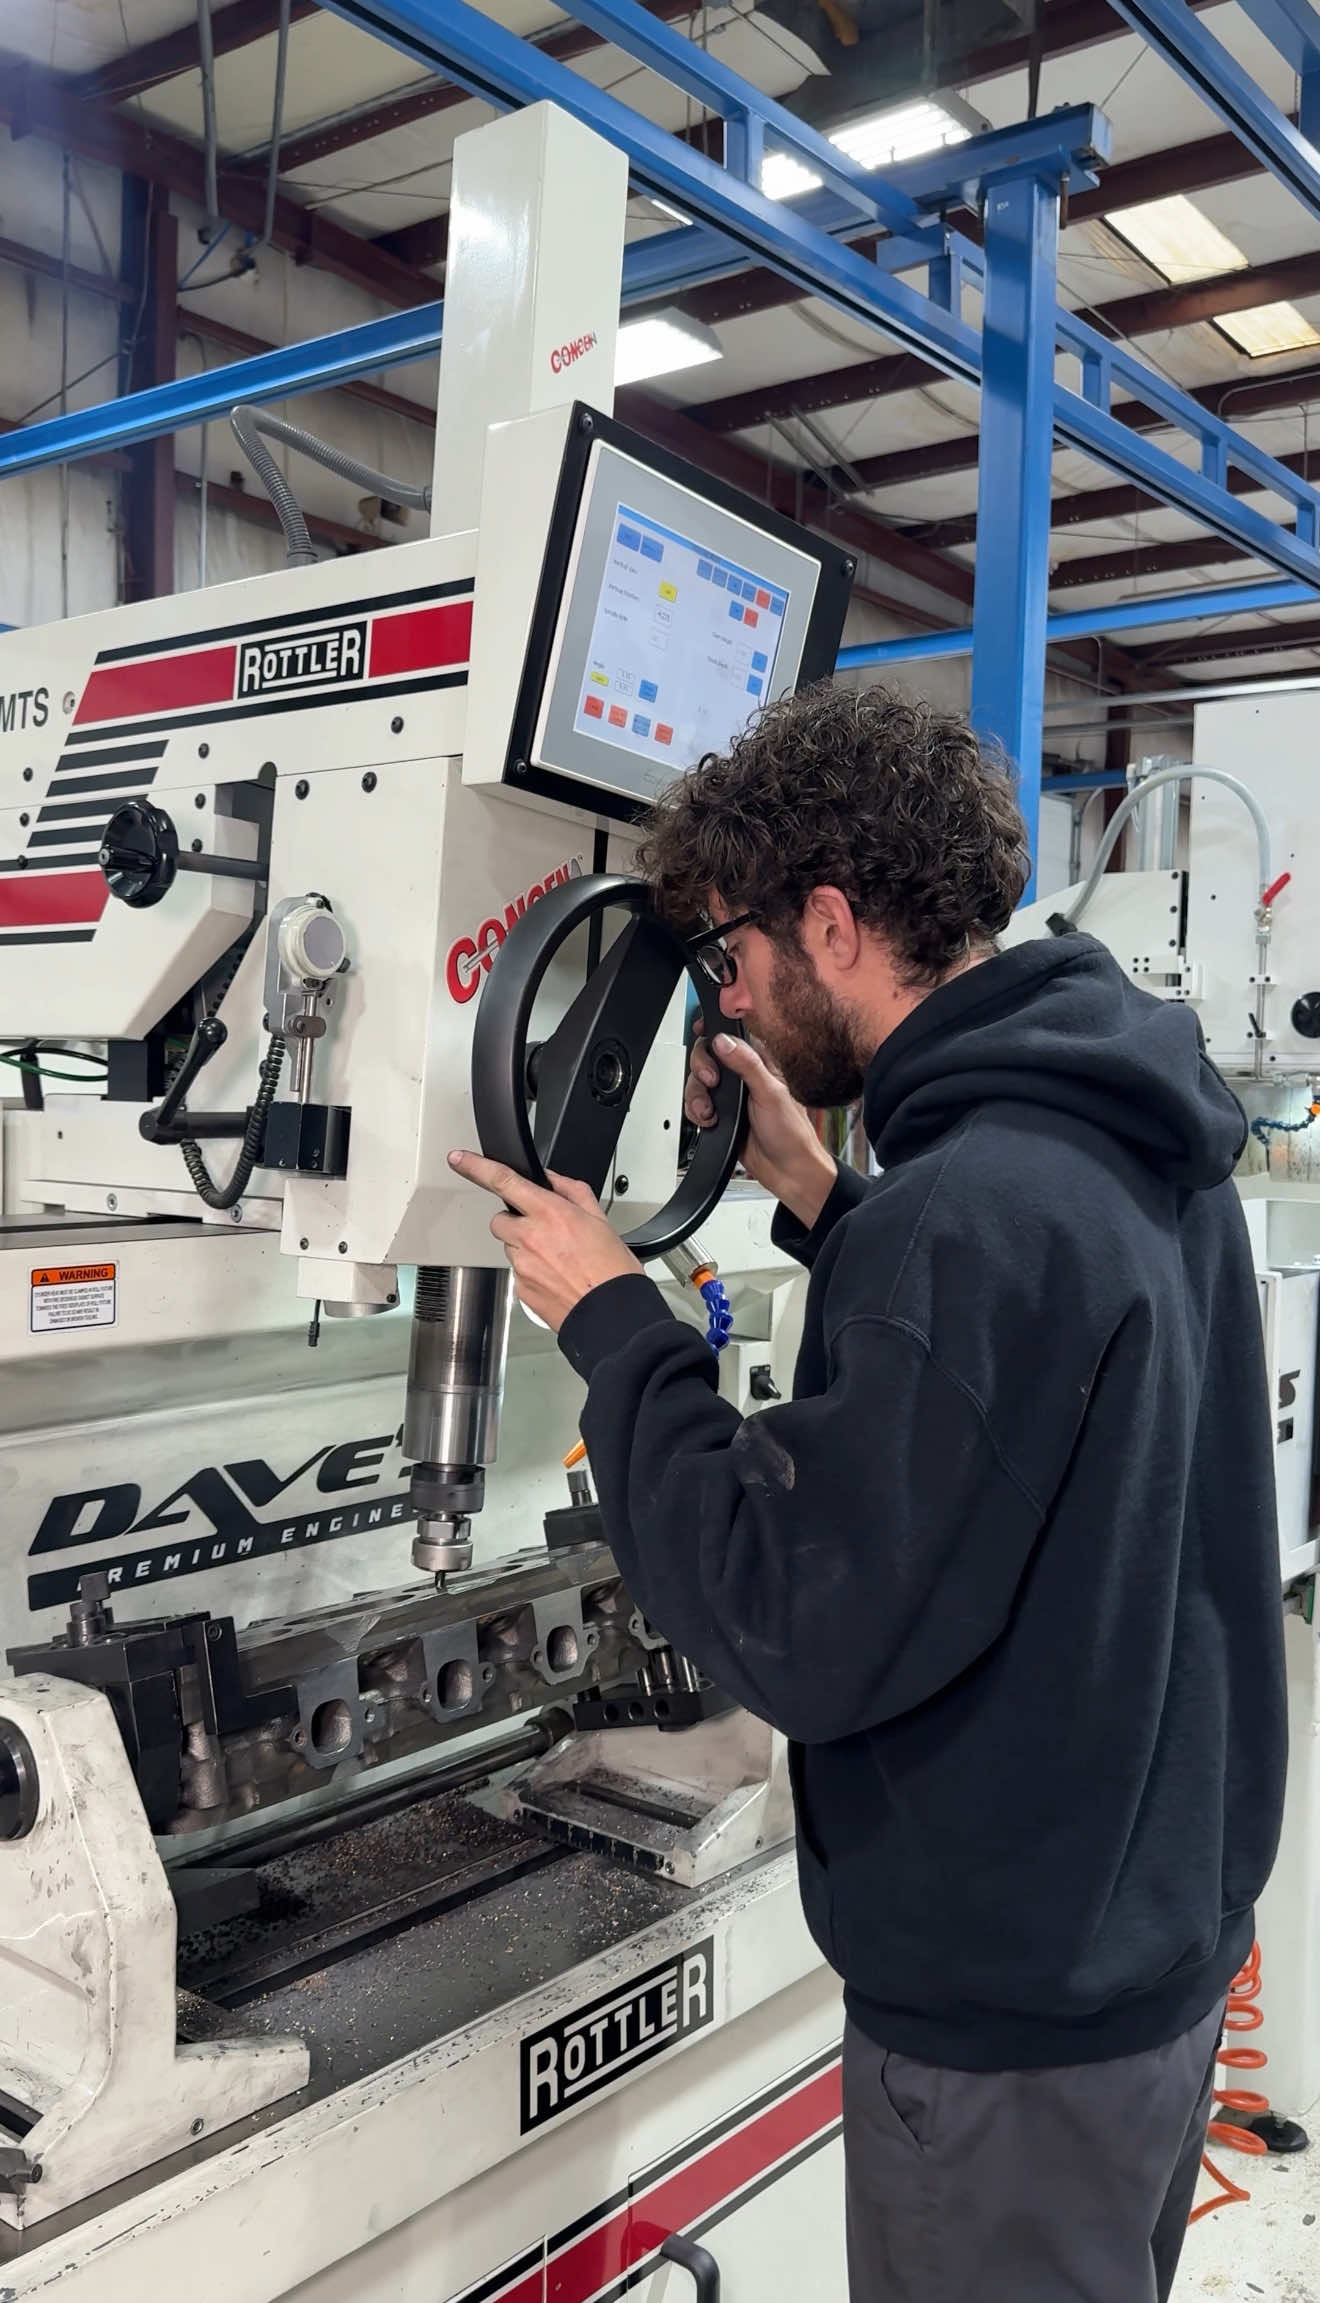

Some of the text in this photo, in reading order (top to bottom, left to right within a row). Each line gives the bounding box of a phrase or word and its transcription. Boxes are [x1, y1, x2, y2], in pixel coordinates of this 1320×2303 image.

[242, 629, 361, 692] ROTTLER
[0, 687, 49, 732] MTS
[58, 1268, 108, 1281] WARNING
[28, 1424, 411, 1556] DAVE'
[77, 1503, 418, 1591] REMIUM ENGINE
[529, 1953, 706, 2119] ROTTLER
